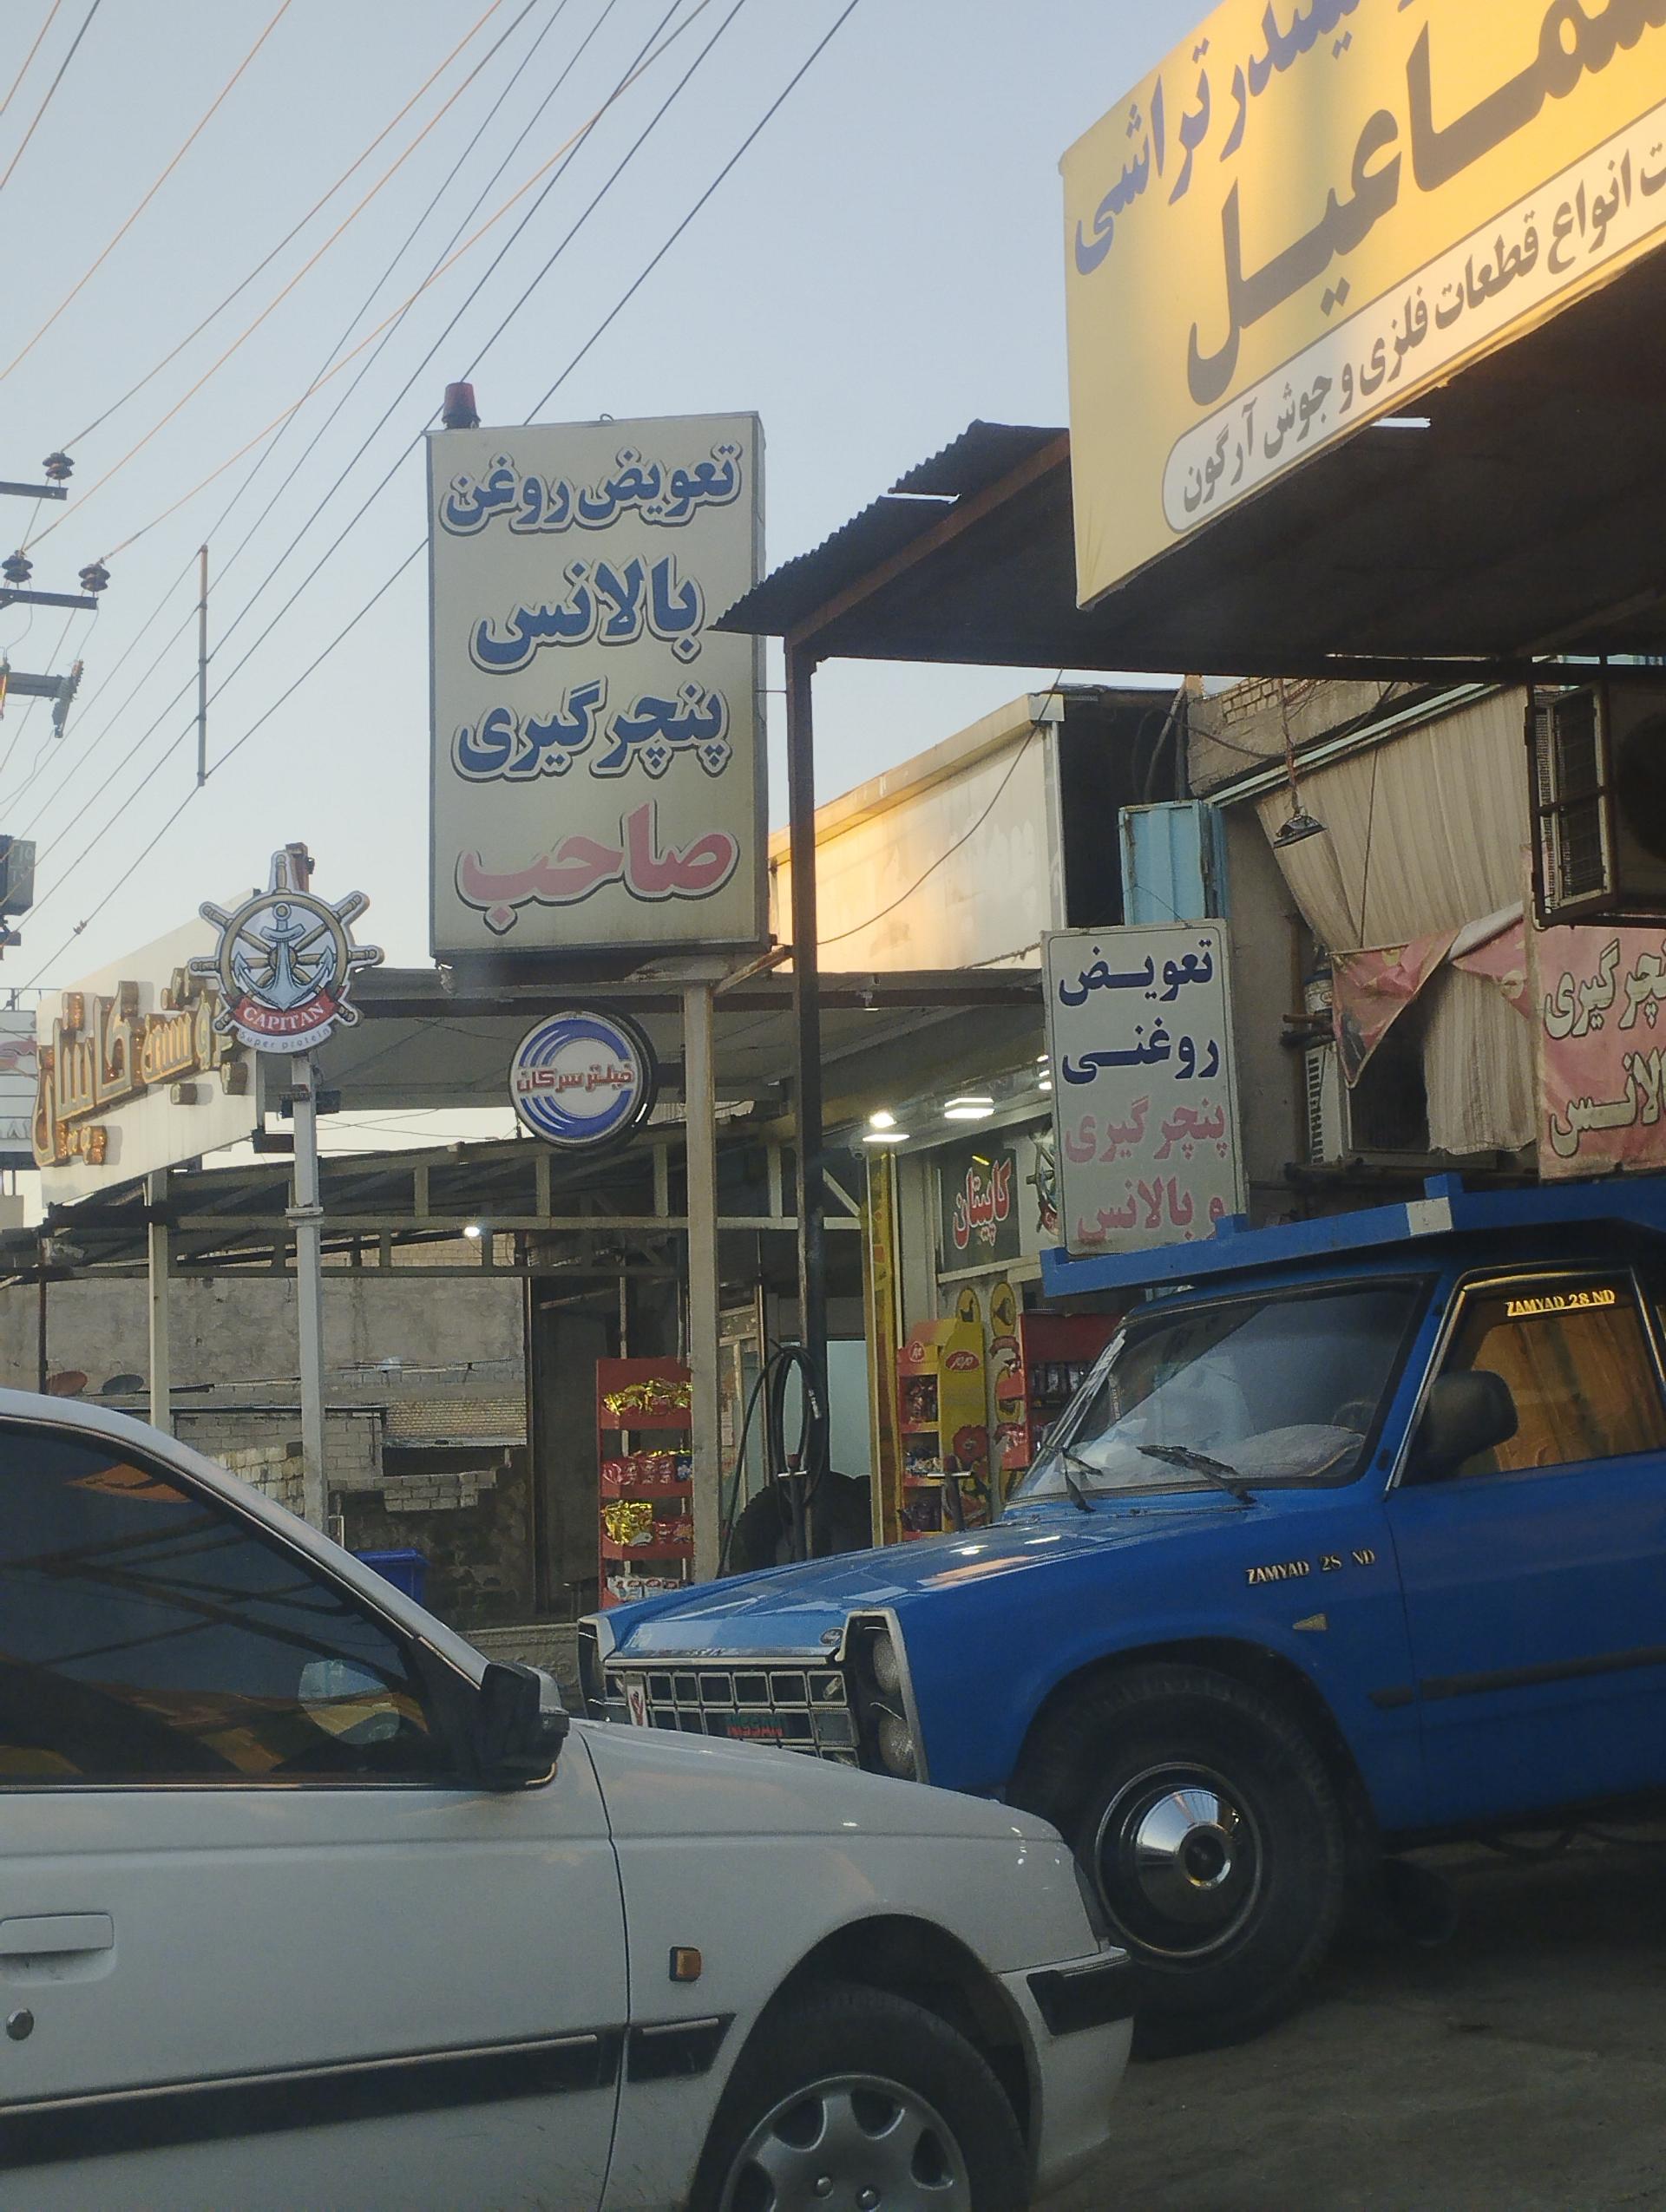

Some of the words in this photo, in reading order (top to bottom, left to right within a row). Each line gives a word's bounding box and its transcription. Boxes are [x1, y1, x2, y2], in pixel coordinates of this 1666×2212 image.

[1547, 148, 1631, 275] انواع
[1435, 210, 1538, 330] قطعات
[1360, 286, 1427, 396] فلزی
[1264, 376, 1333, 459] جوش
[1339, 363, 1354, 414] و
[440, 453, 576, 535] روغن
[578, 442, 742, 527] تعویض
[1184, 396, 1257, 513] آرگون
[469, 553, 704, 673] بالانس
[456, 800, 738, 934] صاحب
[1059, 938, 1214, 1006] تعویض
[243, 1003, 324, 1031] CAPITAN
[1062, 1017, 1220, 1084] روغنی
[585, 1063, 634, 1092] فیلتر
[1078, 1176, 1193, 1243] بالانس
[1505, 1296, 1565, 1316] ZAMYAD
[1569, 1293, 1590, 1307] 28
[1592, 1289, 1615, 1304] ND
[1245, 1561, 1310, 1585] ZAMYAD
